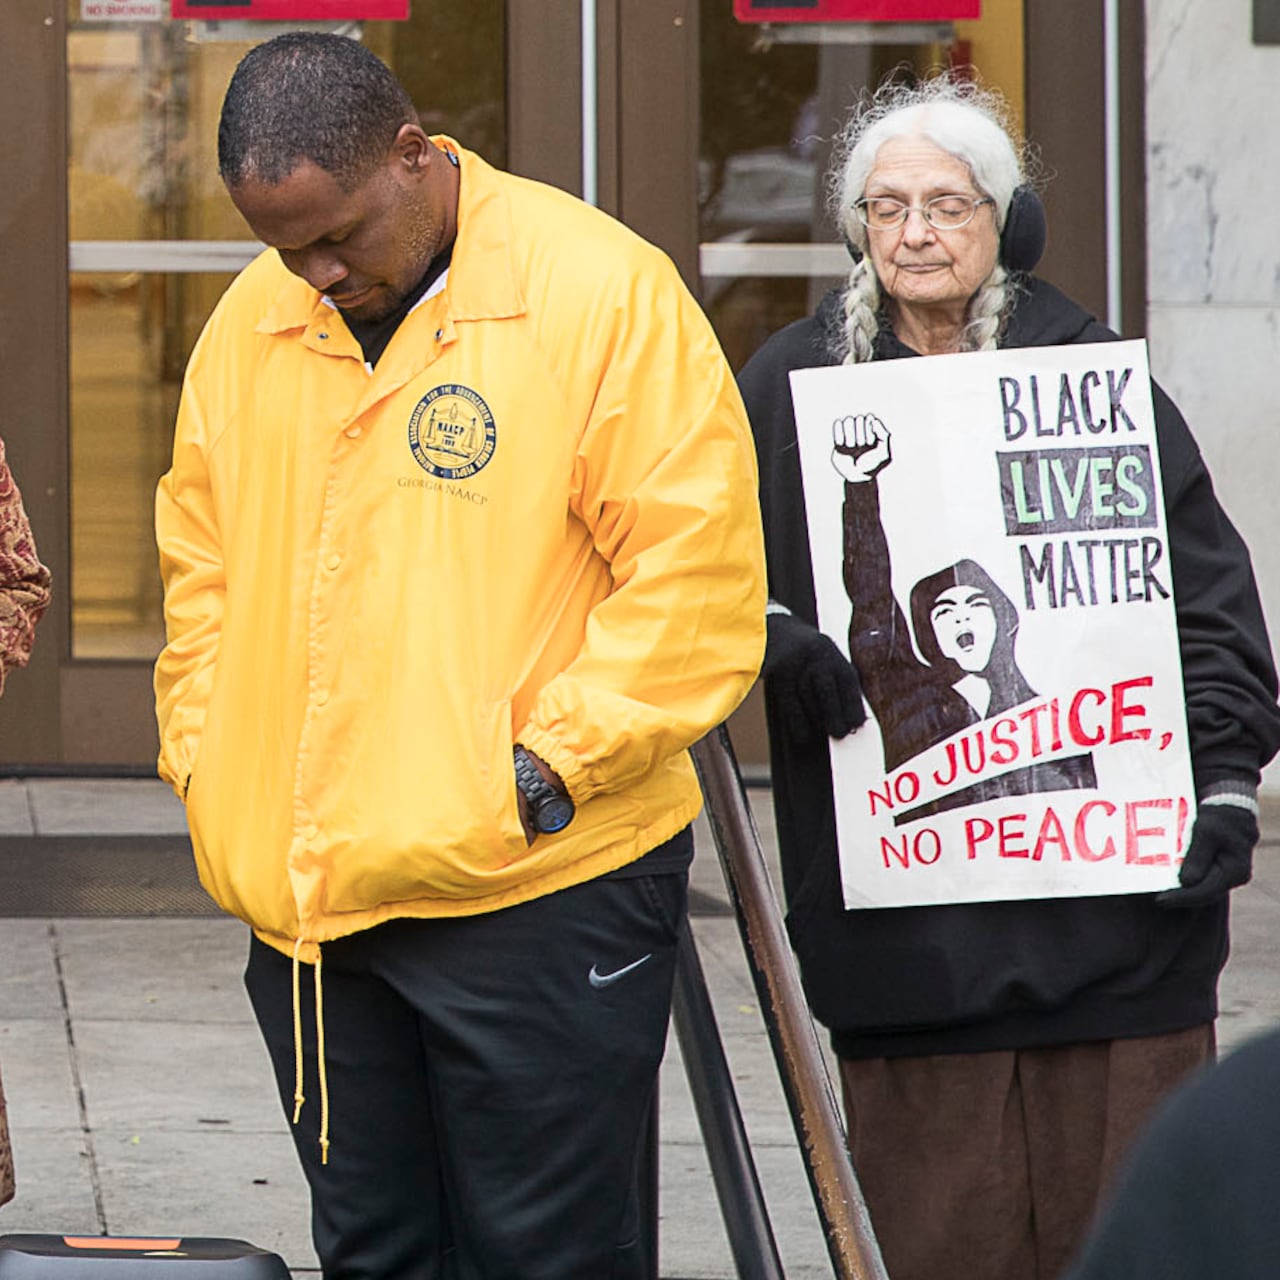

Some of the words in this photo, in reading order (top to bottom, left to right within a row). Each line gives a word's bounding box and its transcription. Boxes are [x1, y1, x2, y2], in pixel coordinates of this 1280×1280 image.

[86, 6, 102, 16] NO
[105, 5, 157, 16] SMOKING
[437, 422, 465, 436] NAACP
[999, 368, 1137, 442] BLACK
[397, 477, 443, 492] GEORGIA
[445, 484, 488, 505] NAACP
[1010, 455, 1148, 524] LIVES
[1019, 536, 1171, 610] MATTER
[867, 771, 921, 816] NO
[933, 676, 1174, 786] JUSTICE,
[880, 828, 942, 869] NO
[964, 796, 1188, 867] PEACE!
